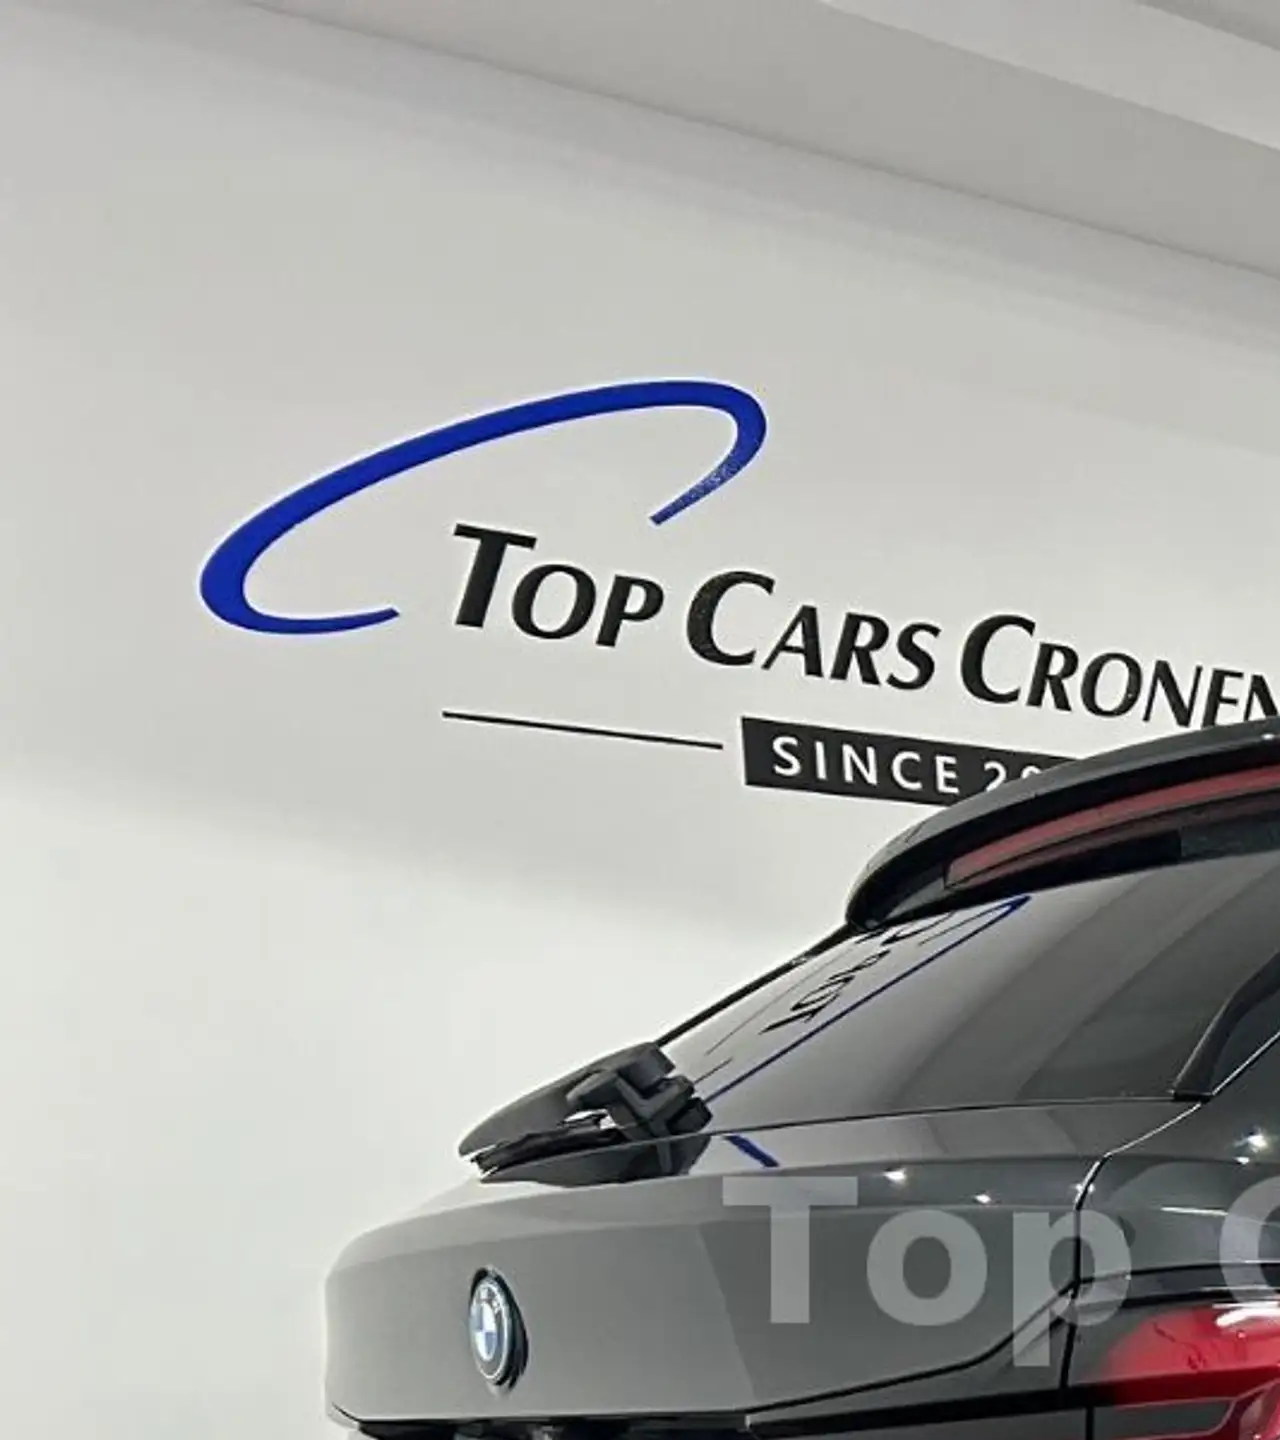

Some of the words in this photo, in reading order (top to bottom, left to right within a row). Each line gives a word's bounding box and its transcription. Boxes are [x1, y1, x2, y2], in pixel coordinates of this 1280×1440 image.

[453, 523, 664, 648] TOP
[686, 571, 941, 690] CARS
[772, 736, 960, 794] SINCE
